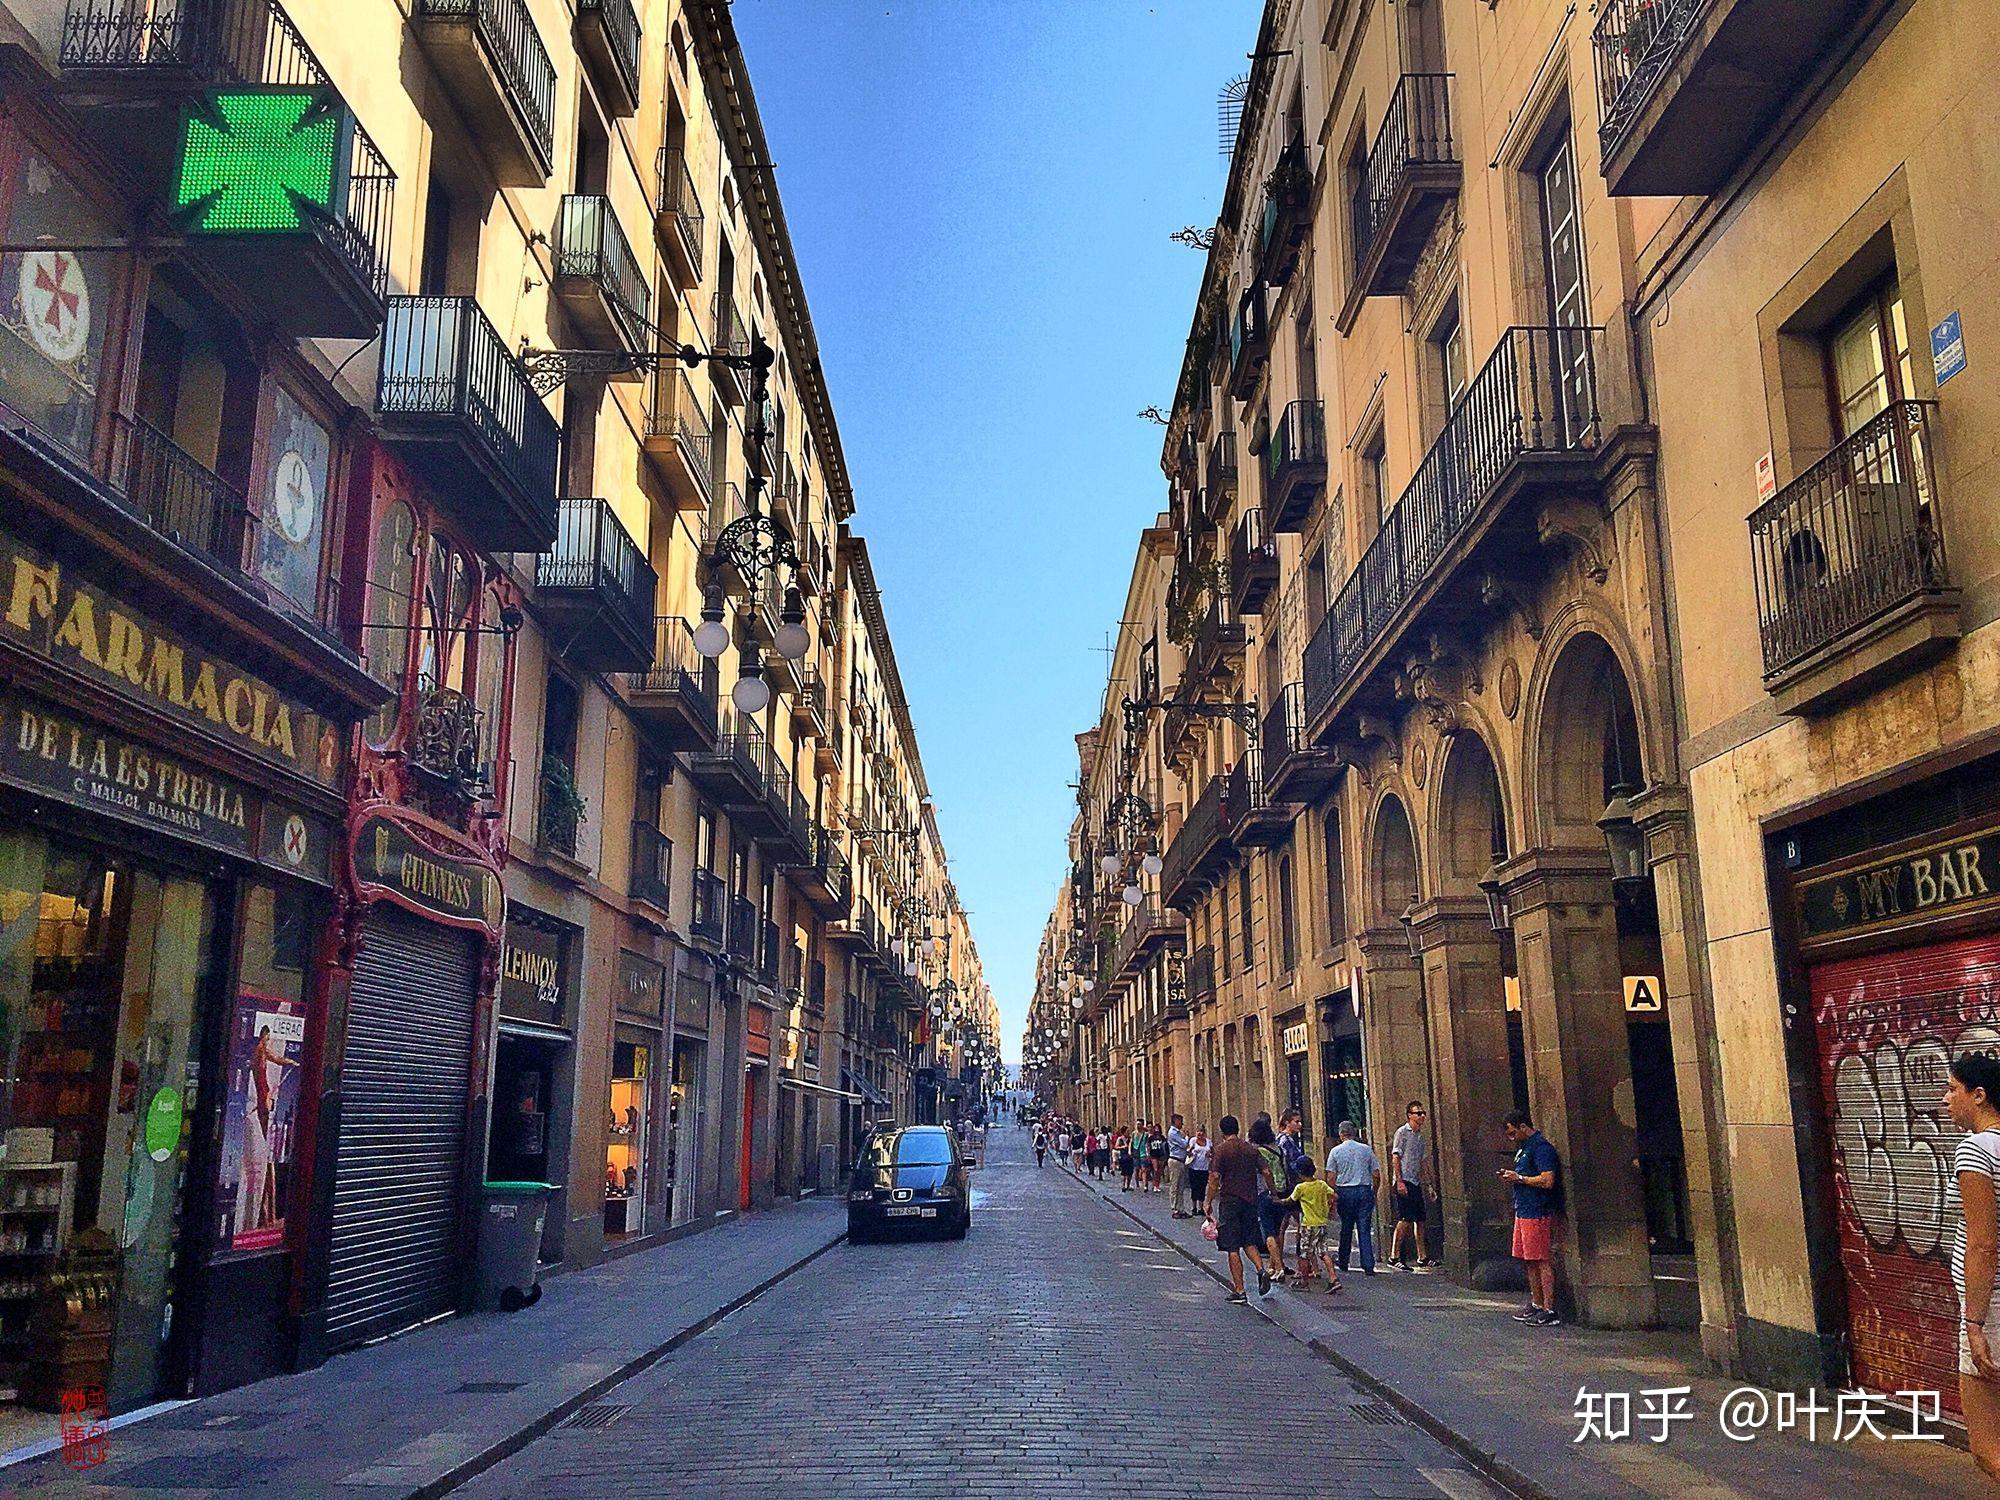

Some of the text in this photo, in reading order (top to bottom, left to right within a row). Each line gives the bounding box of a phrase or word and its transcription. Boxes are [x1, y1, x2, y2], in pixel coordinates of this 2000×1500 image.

[5, 555, 296, 759] FARMACIA
[18, 711, 245, 827] DE LA ESTRELLA
[90, 782, 142, 811] MALLOL
[148, 801, 201, 831] BALMAÑA
[1787, 841, 1796, 859] B
[401, 852, 471, 910] GUINNESS
[1857, 846, 1989, 920] MY BAR
[504, 944, 559, 991] LENNOX
[1630, 979, 1657, 1008] A
